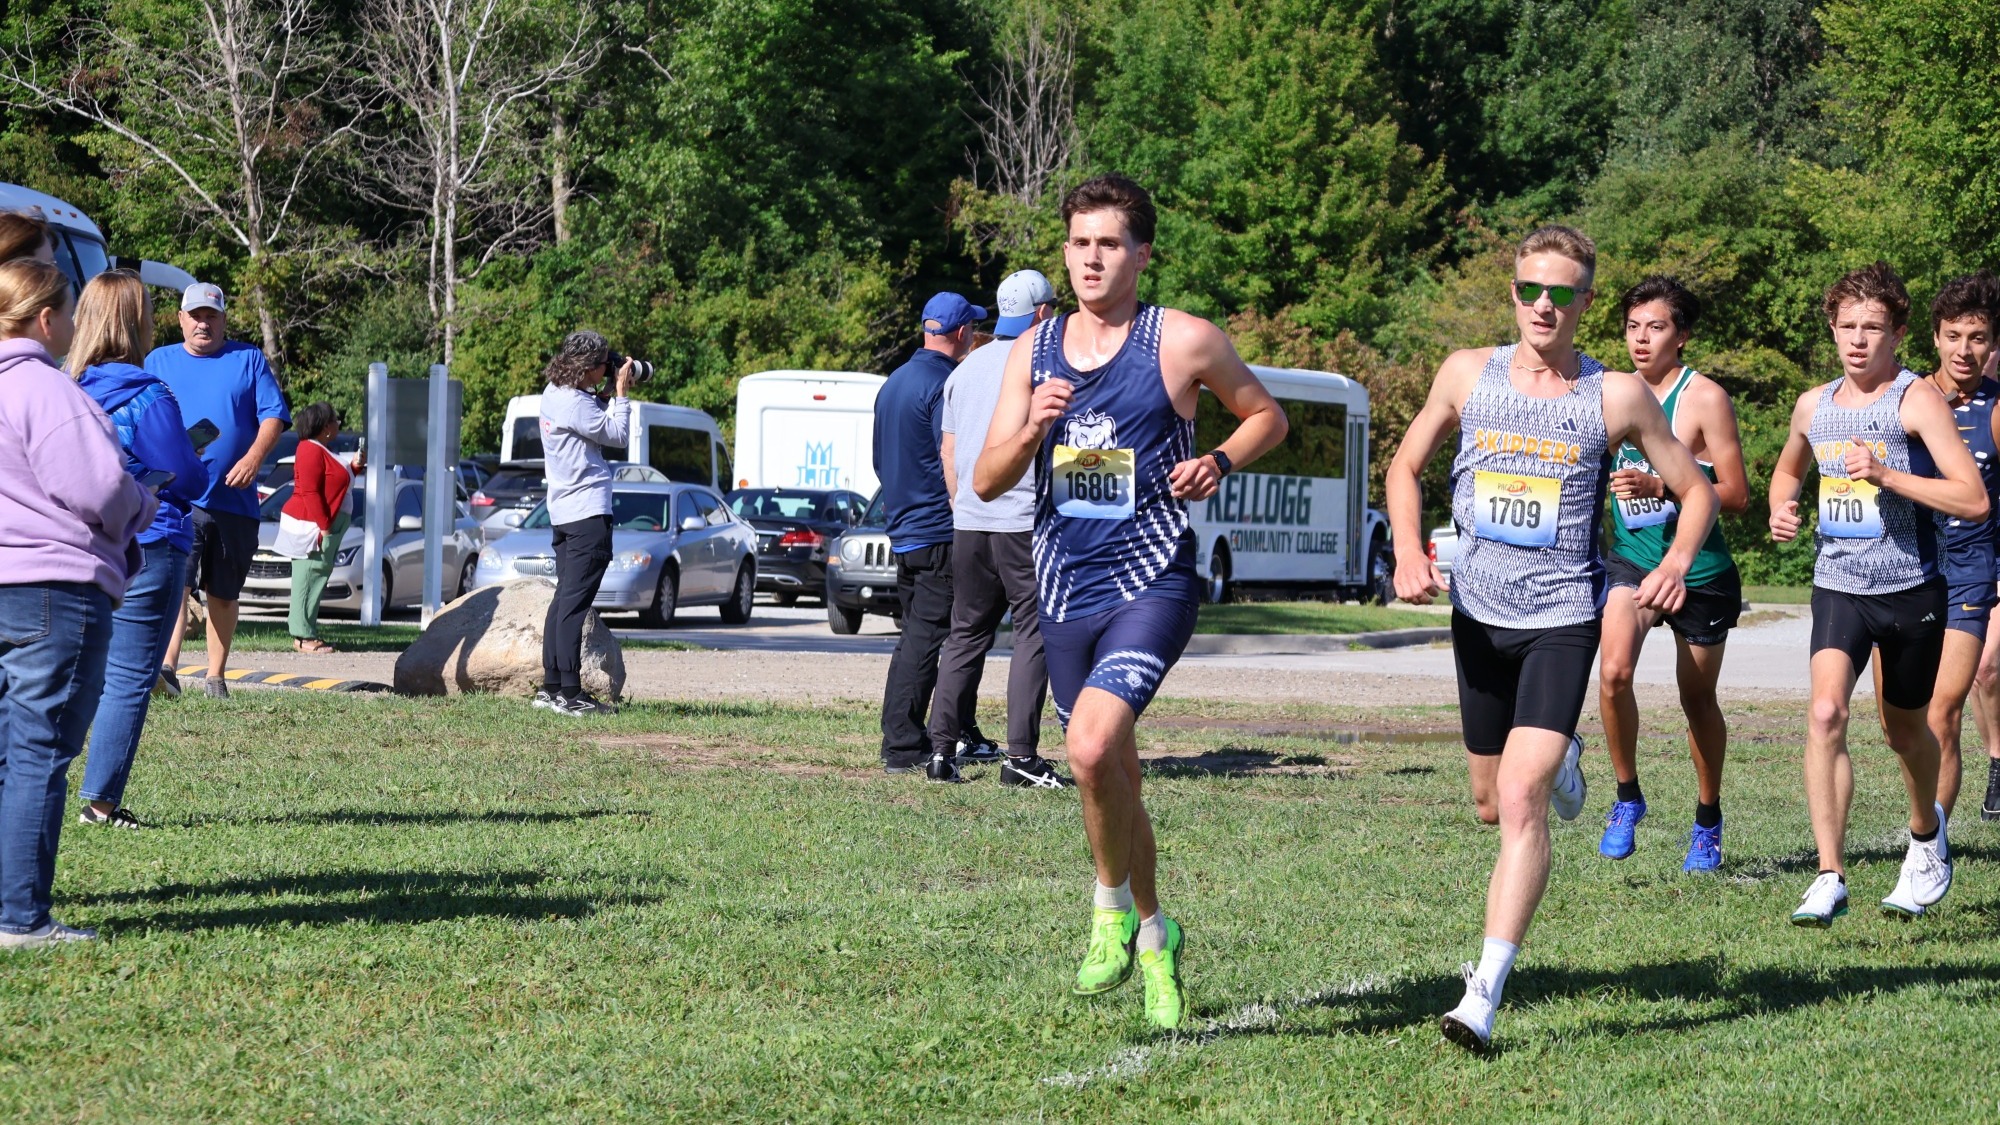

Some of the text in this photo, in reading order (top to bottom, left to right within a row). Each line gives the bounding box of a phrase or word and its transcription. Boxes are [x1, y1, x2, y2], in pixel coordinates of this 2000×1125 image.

[1475, 429, 1581, 466] SKIPPERS
[1814, 441, 1887, 460] SKIPPS
[1065, 471, 1118, 502] 1680
[1206, 473, 1312, 526] KELLOGG
[1489, 496, 1542, 529] 1709
[1827, 498, 1863, 523] 1710
[1230, 529, 1294, 553] COMMUNITY
[1296, 531, 1339, 554] COLLEGE
